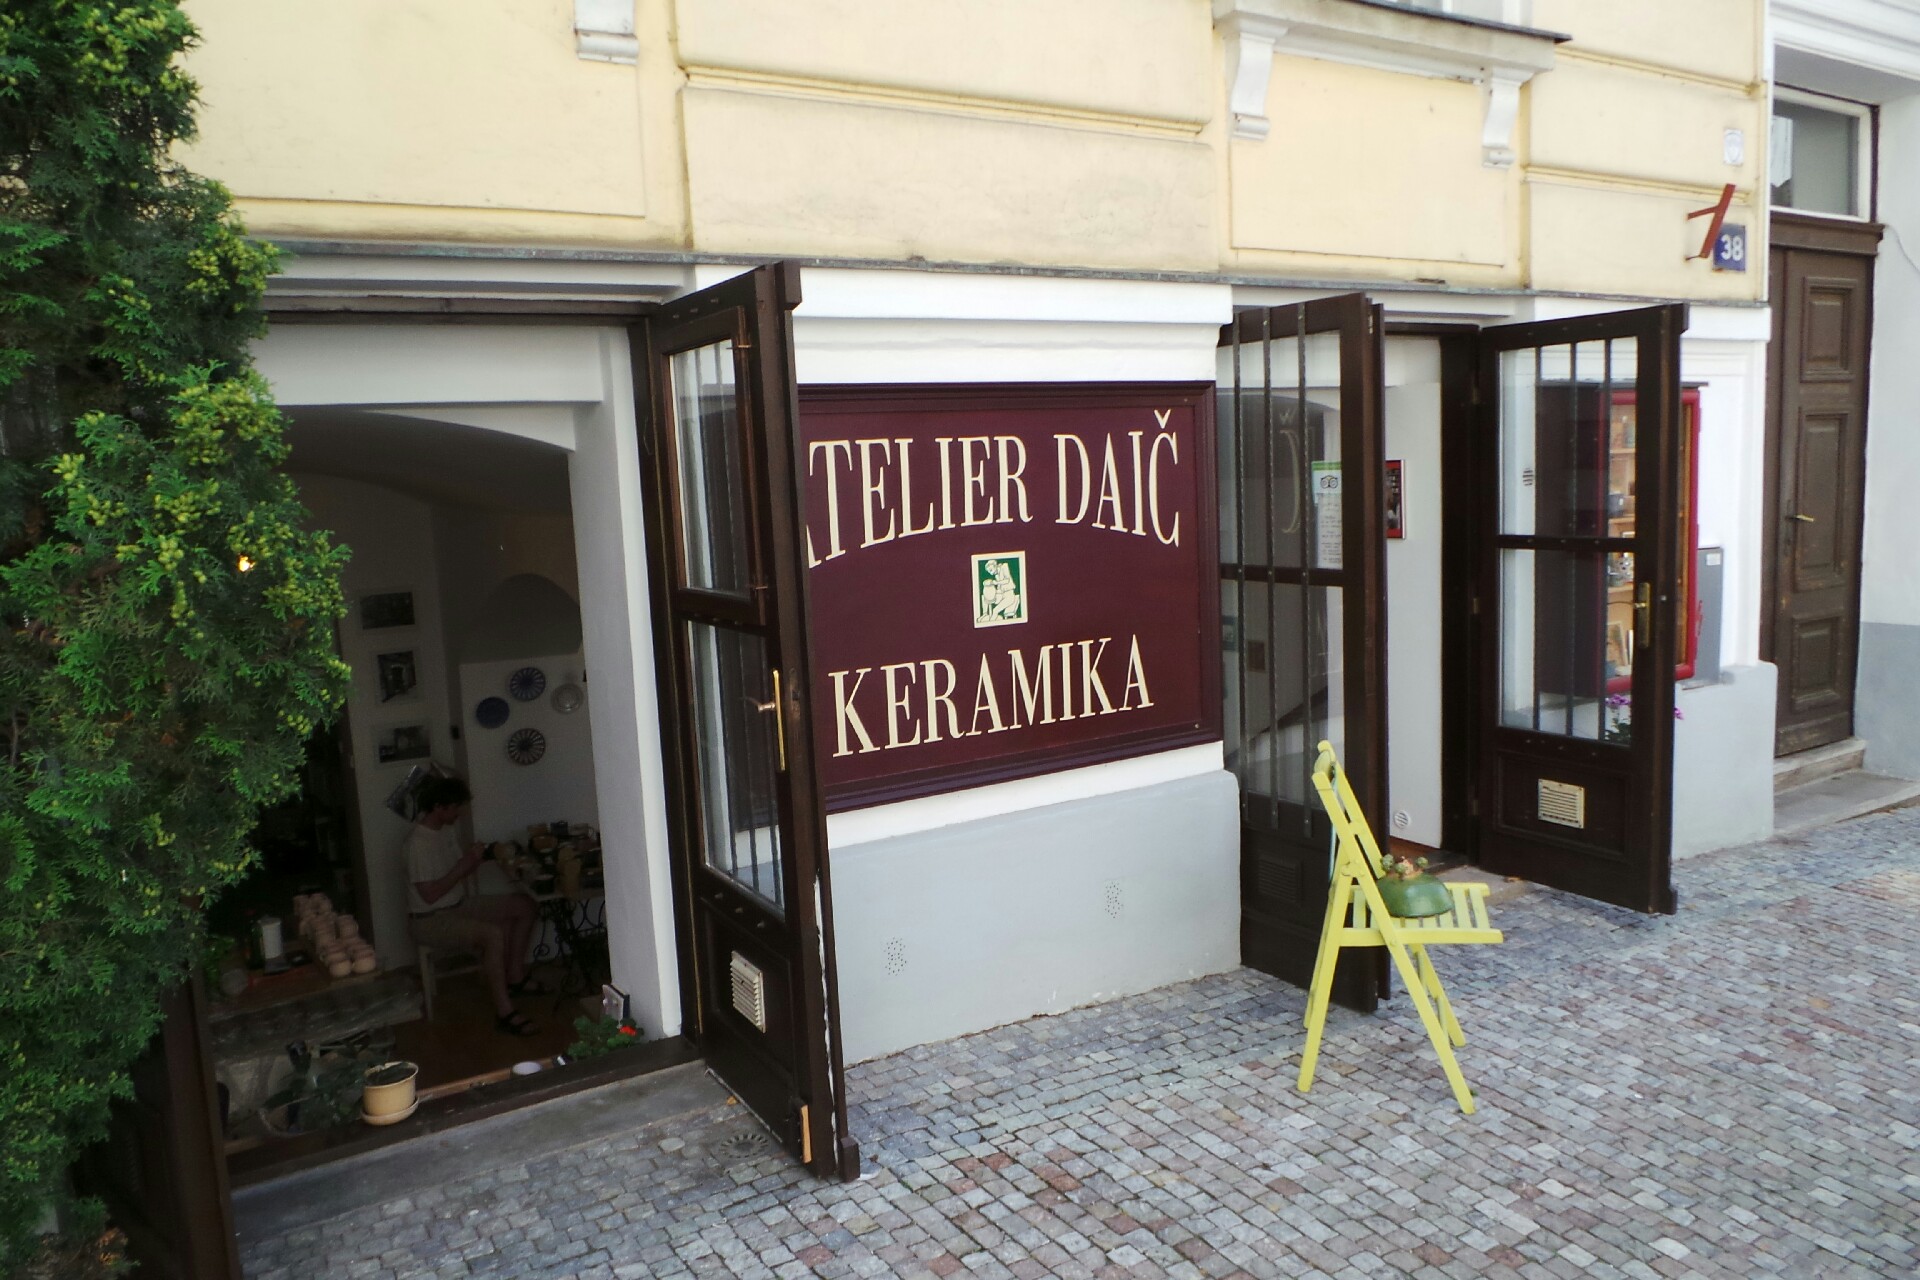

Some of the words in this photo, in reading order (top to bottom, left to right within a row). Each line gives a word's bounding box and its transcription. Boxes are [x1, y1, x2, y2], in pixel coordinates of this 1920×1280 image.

[1721, 234, 1744, 261] 38
[806, 435, 1033, 569] TELIER
[1053, 409, 1180, 547] DAIČ
[828, 634, 1154, 758] KERAMIKA
